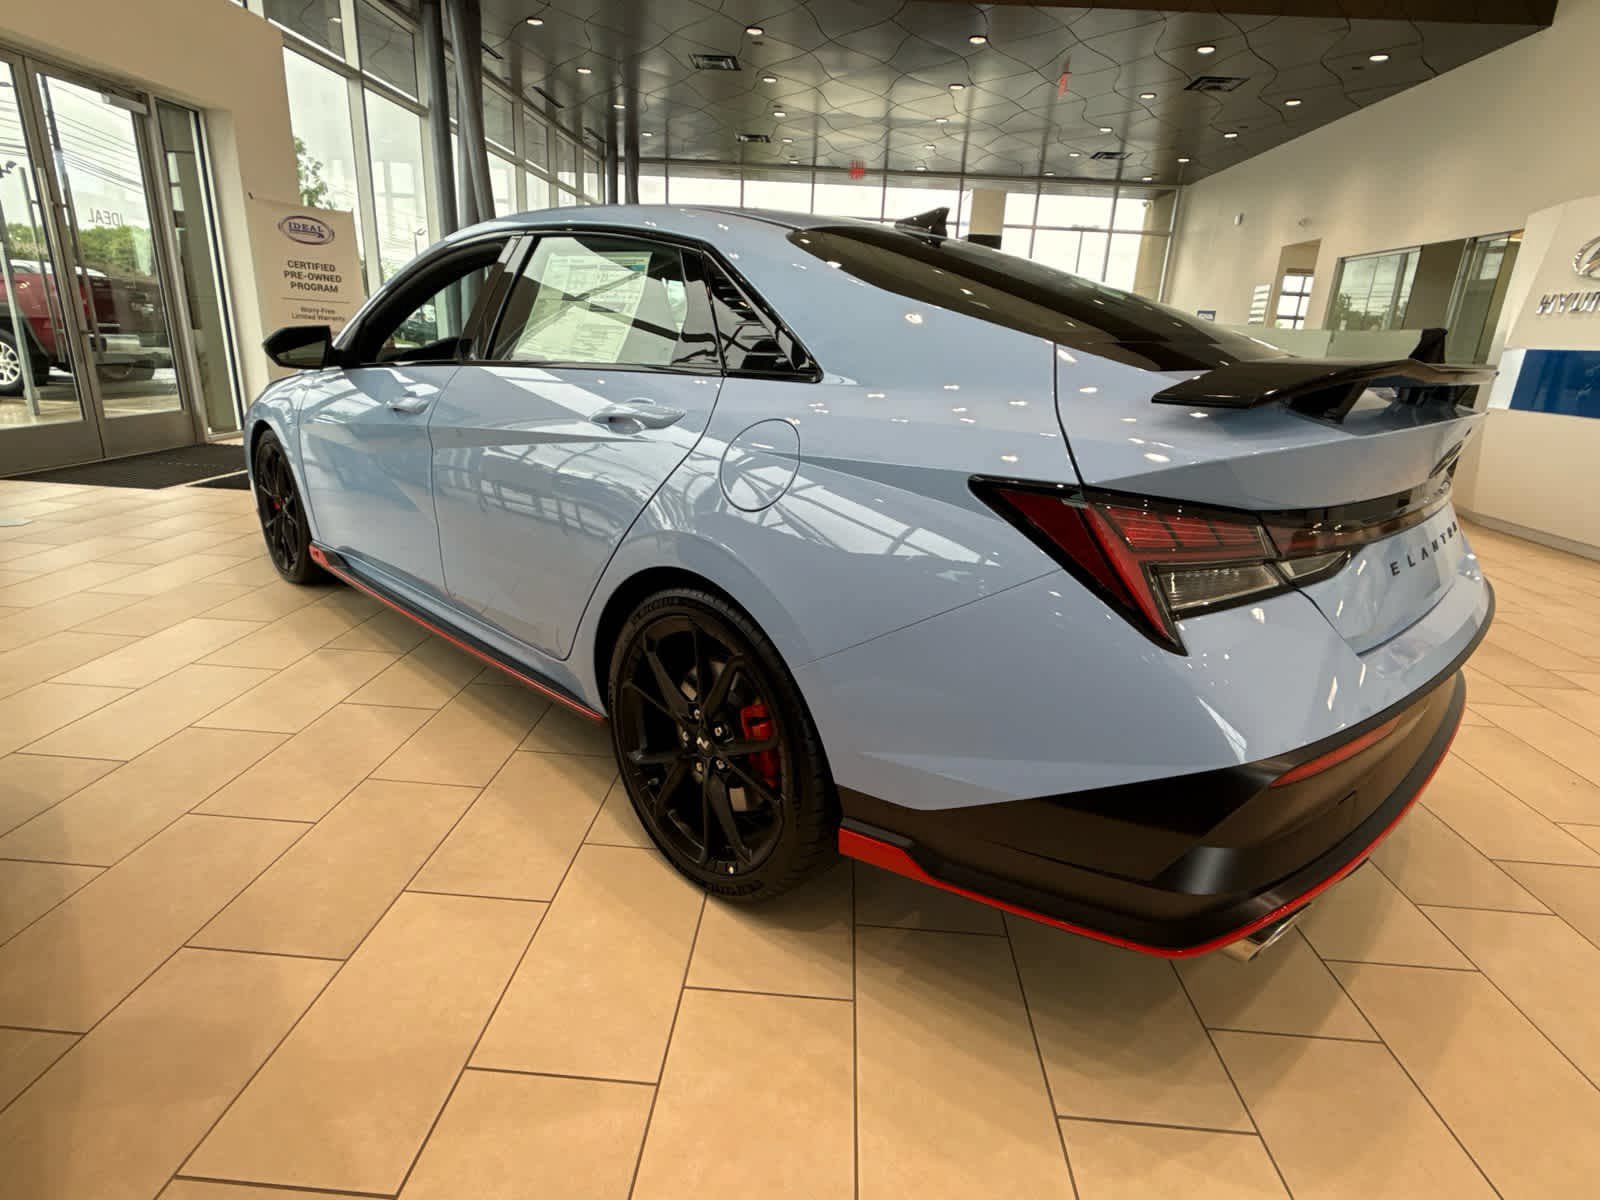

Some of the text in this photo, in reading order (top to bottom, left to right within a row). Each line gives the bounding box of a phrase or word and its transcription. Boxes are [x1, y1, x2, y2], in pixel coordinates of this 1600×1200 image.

[288, 221, 324, 233] IDEAL
[287, 260, 336, 272] CERTIFIED
[283, 270, 342, 283] PRE-OWNED
[290, 281, 338, 293] PROGRAM
